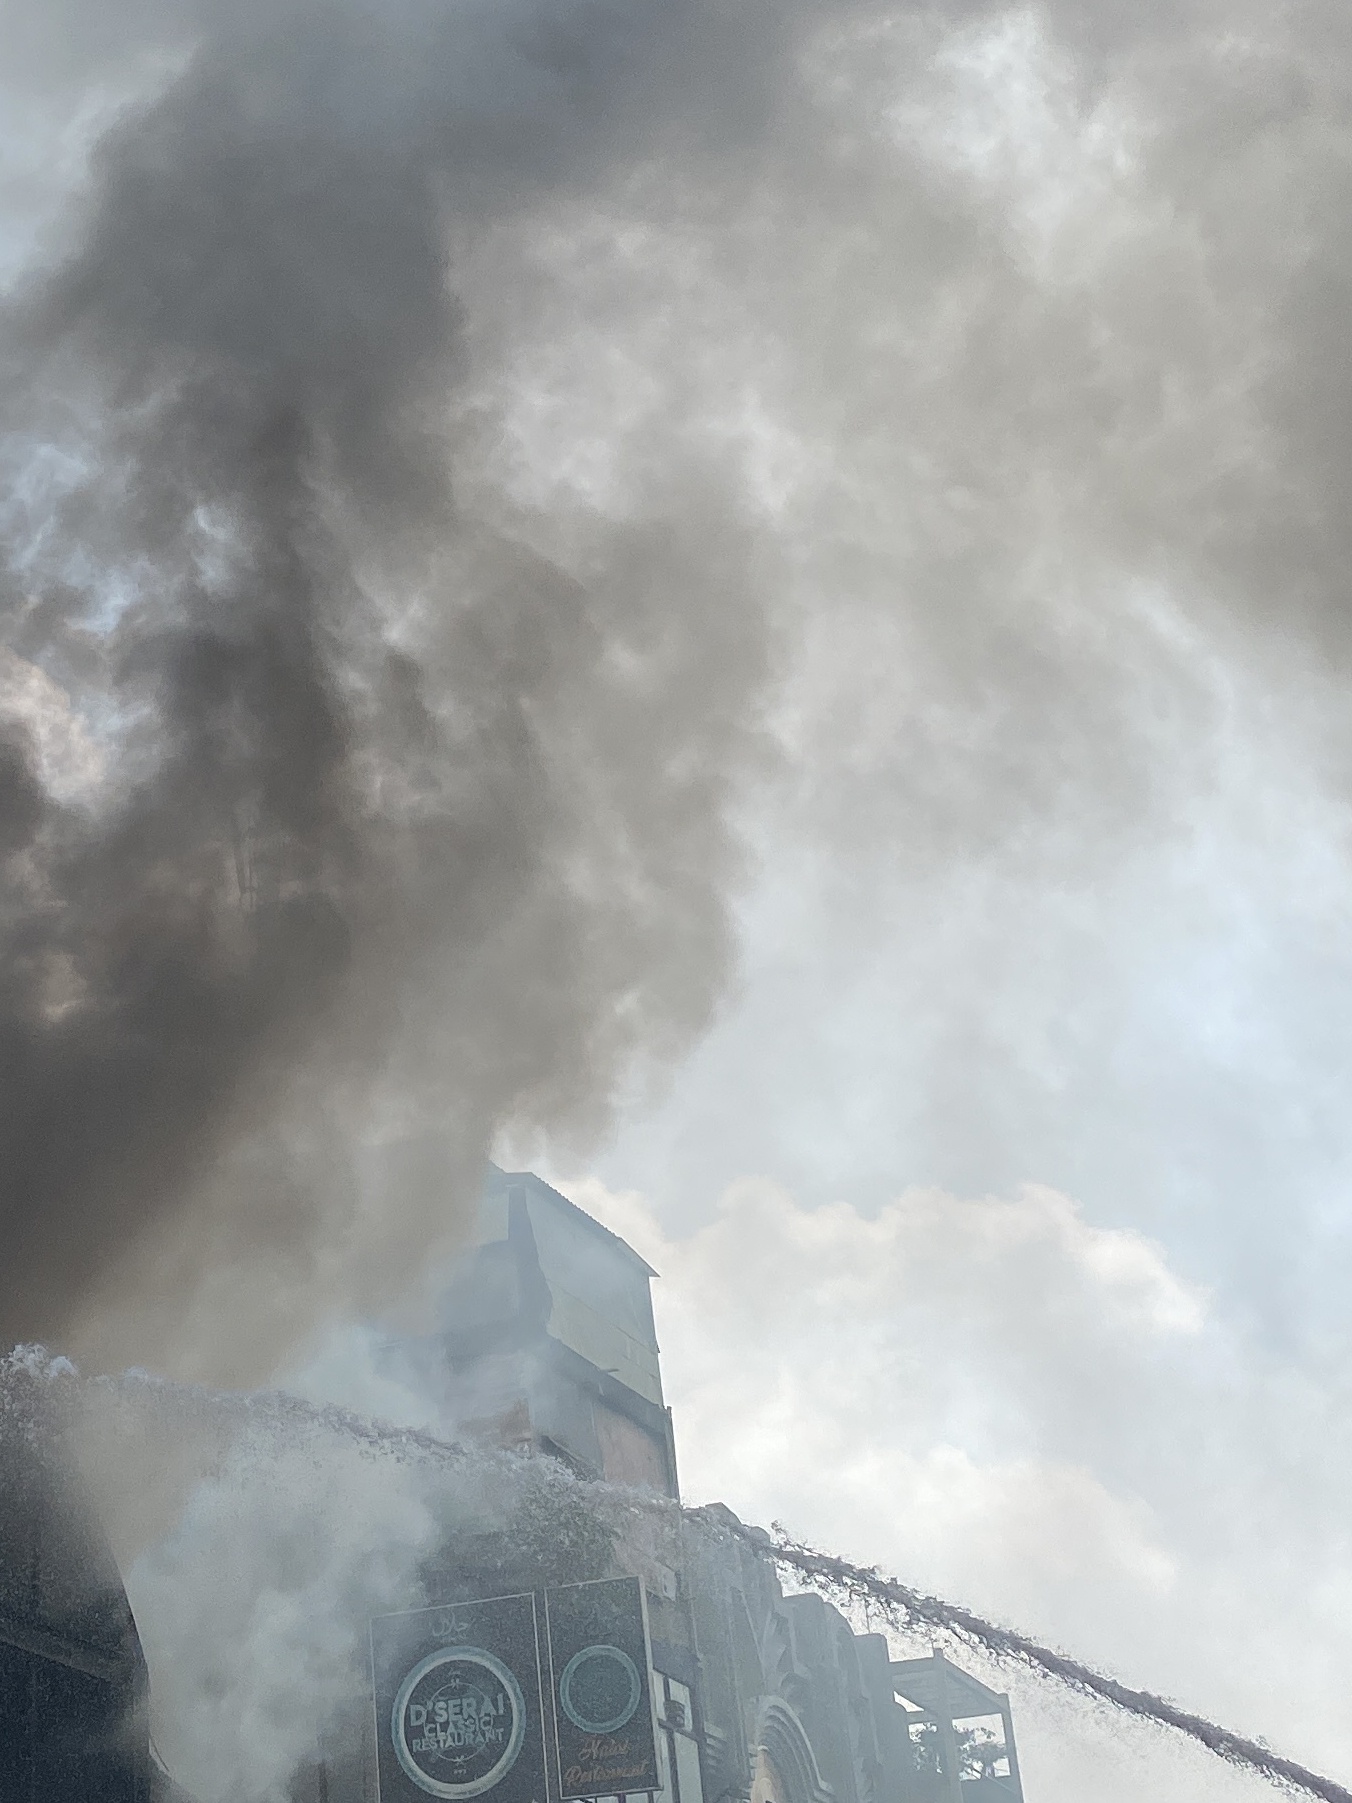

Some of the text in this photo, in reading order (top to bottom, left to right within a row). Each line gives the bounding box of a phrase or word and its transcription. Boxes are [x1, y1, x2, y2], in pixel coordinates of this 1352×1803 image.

[409, 1693, 505, 1727] D'SERAI
[425, 1716, 492, 1738] CLASSIC
[412, 1728, 505, 1753] RESTAURANT
